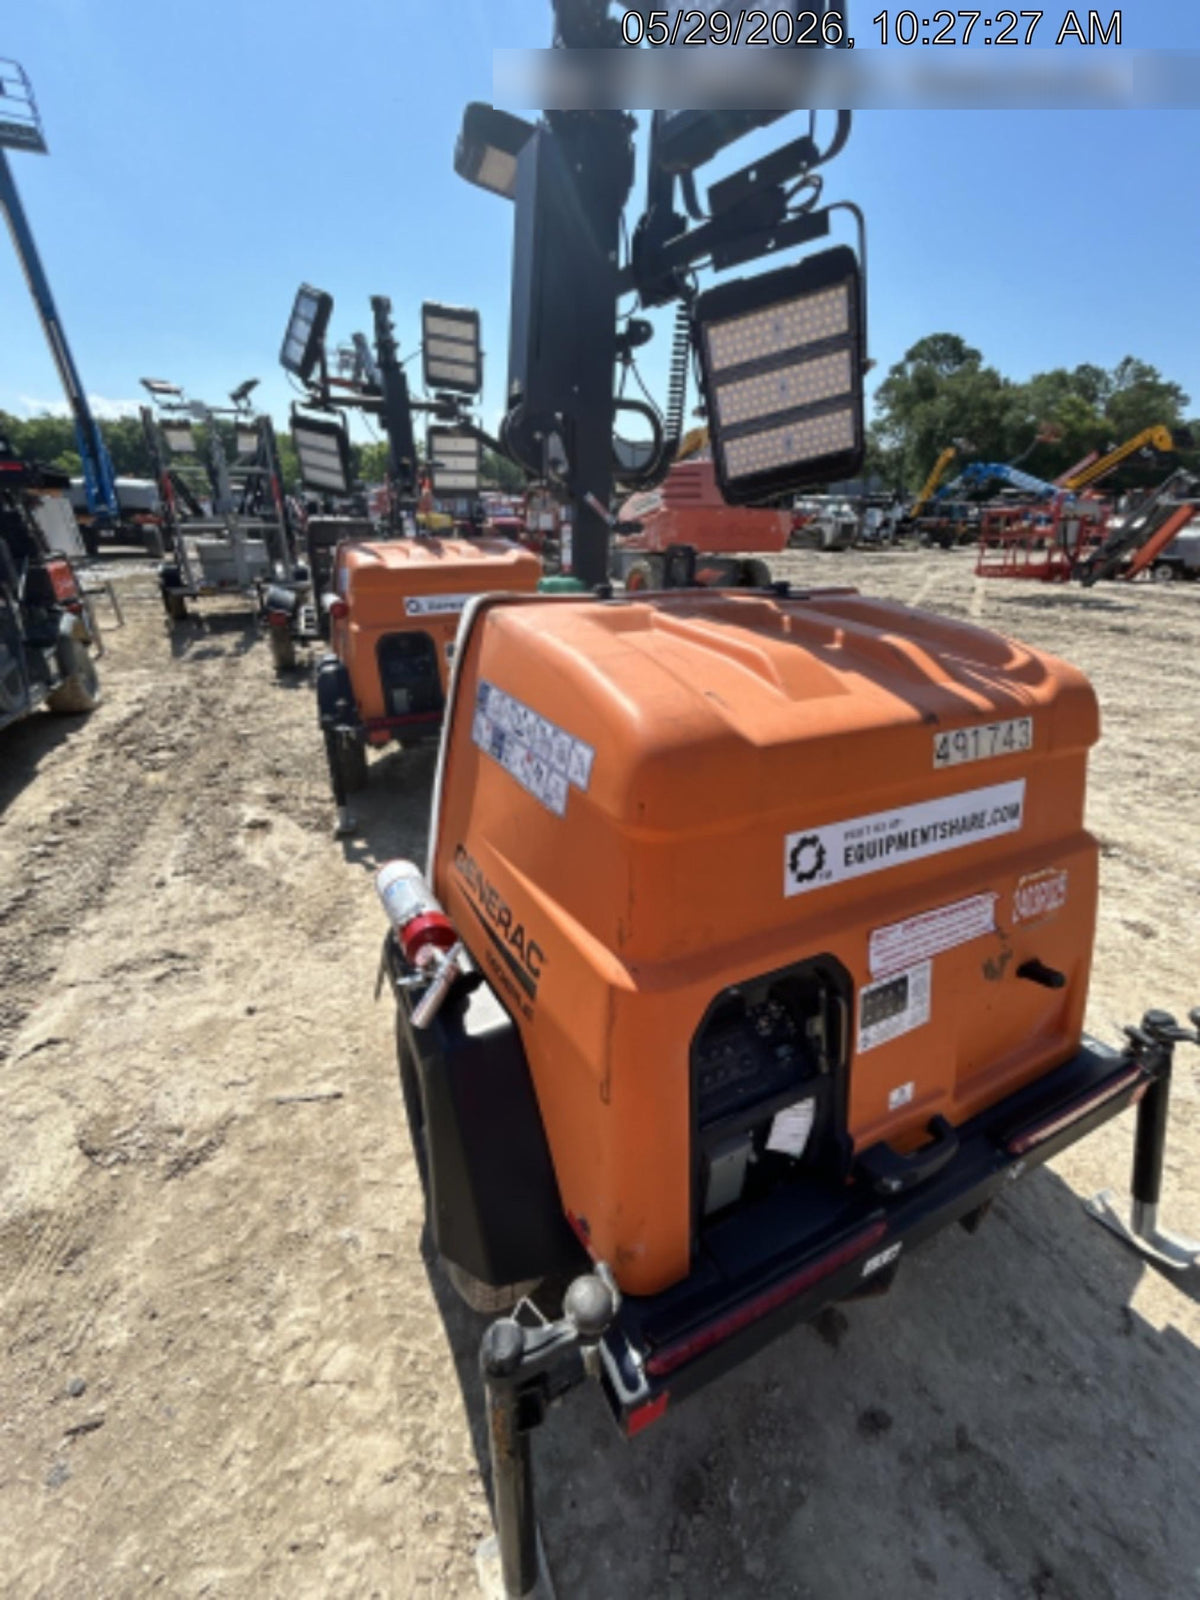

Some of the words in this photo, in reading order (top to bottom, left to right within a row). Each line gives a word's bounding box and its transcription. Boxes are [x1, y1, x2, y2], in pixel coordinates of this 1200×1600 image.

[936, 718, 1030, 763] 491743
[843, 802, 1021, 868] EQUIPMENTSHARE.COM
[454, 843, 546, 978] GENERAC
